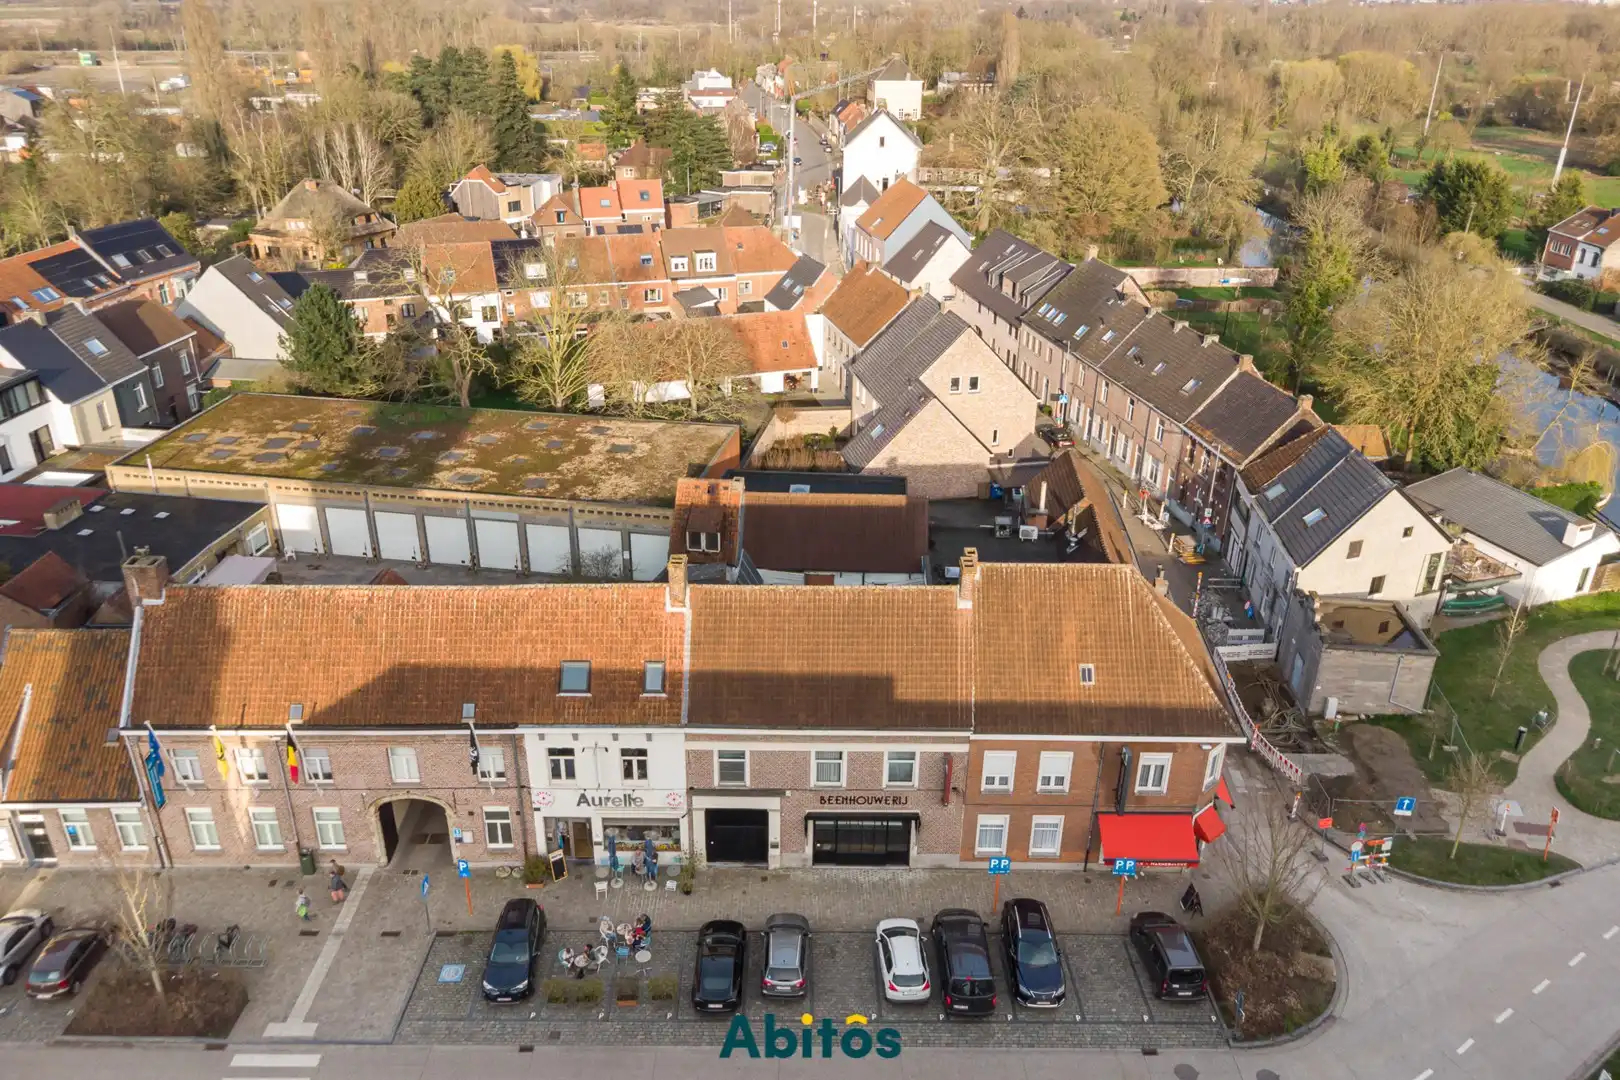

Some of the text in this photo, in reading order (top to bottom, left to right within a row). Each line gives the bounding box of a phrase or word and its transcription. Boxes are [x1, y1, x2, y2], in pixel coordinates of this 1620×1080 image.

[576, 792, 644, 808] Aurelle
[819, 795, 909, 806] BEENHOUWERIJ
[459, 861, 468, 871] P
